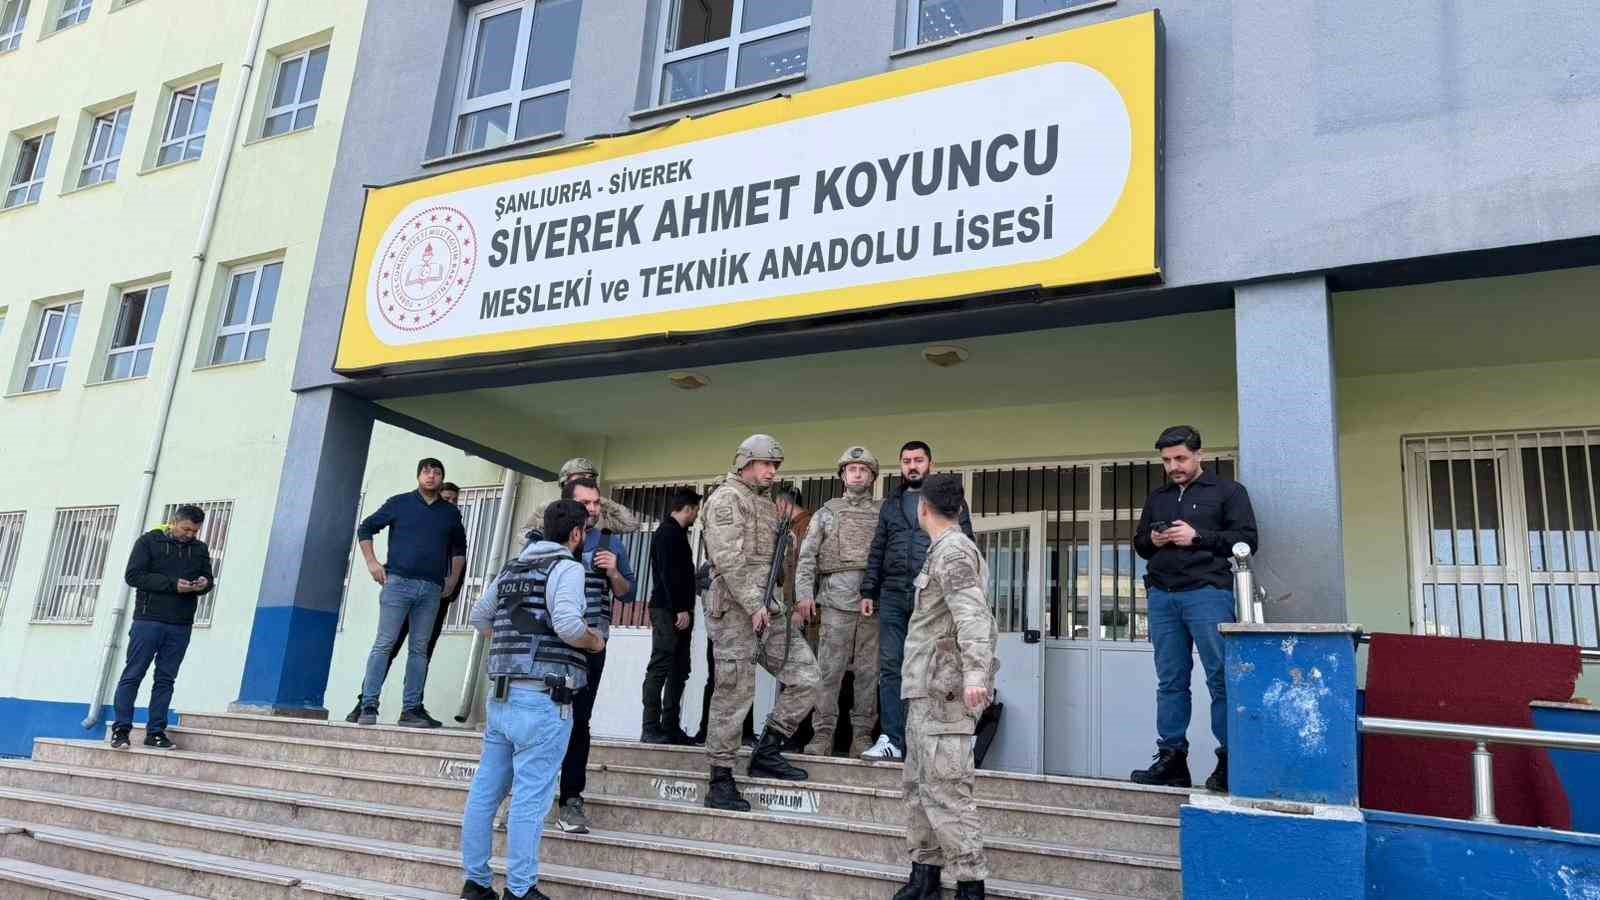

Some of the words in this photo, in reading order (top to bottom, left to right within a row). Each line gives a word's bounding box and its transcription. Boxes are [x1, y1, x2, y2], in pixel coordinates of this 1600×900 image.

[487, 204, 644, 268] SİVEREK
[653, 174, 801, 242] AHMET
[814, 124, 1059, 215] KOYUNCU
[494, 180, 592, 222] ŞANLIURFA
[609, 158, 693, 195] SİVEREK
[480, 269, 592, 320] MESLEKİ
[601, 281, 629, 303] ve
[640, 248, 751, 298] TEKNİK
[759, 225, 920, 282] ANADOLU
[934, 194, 1053, 257] LİSESİ
